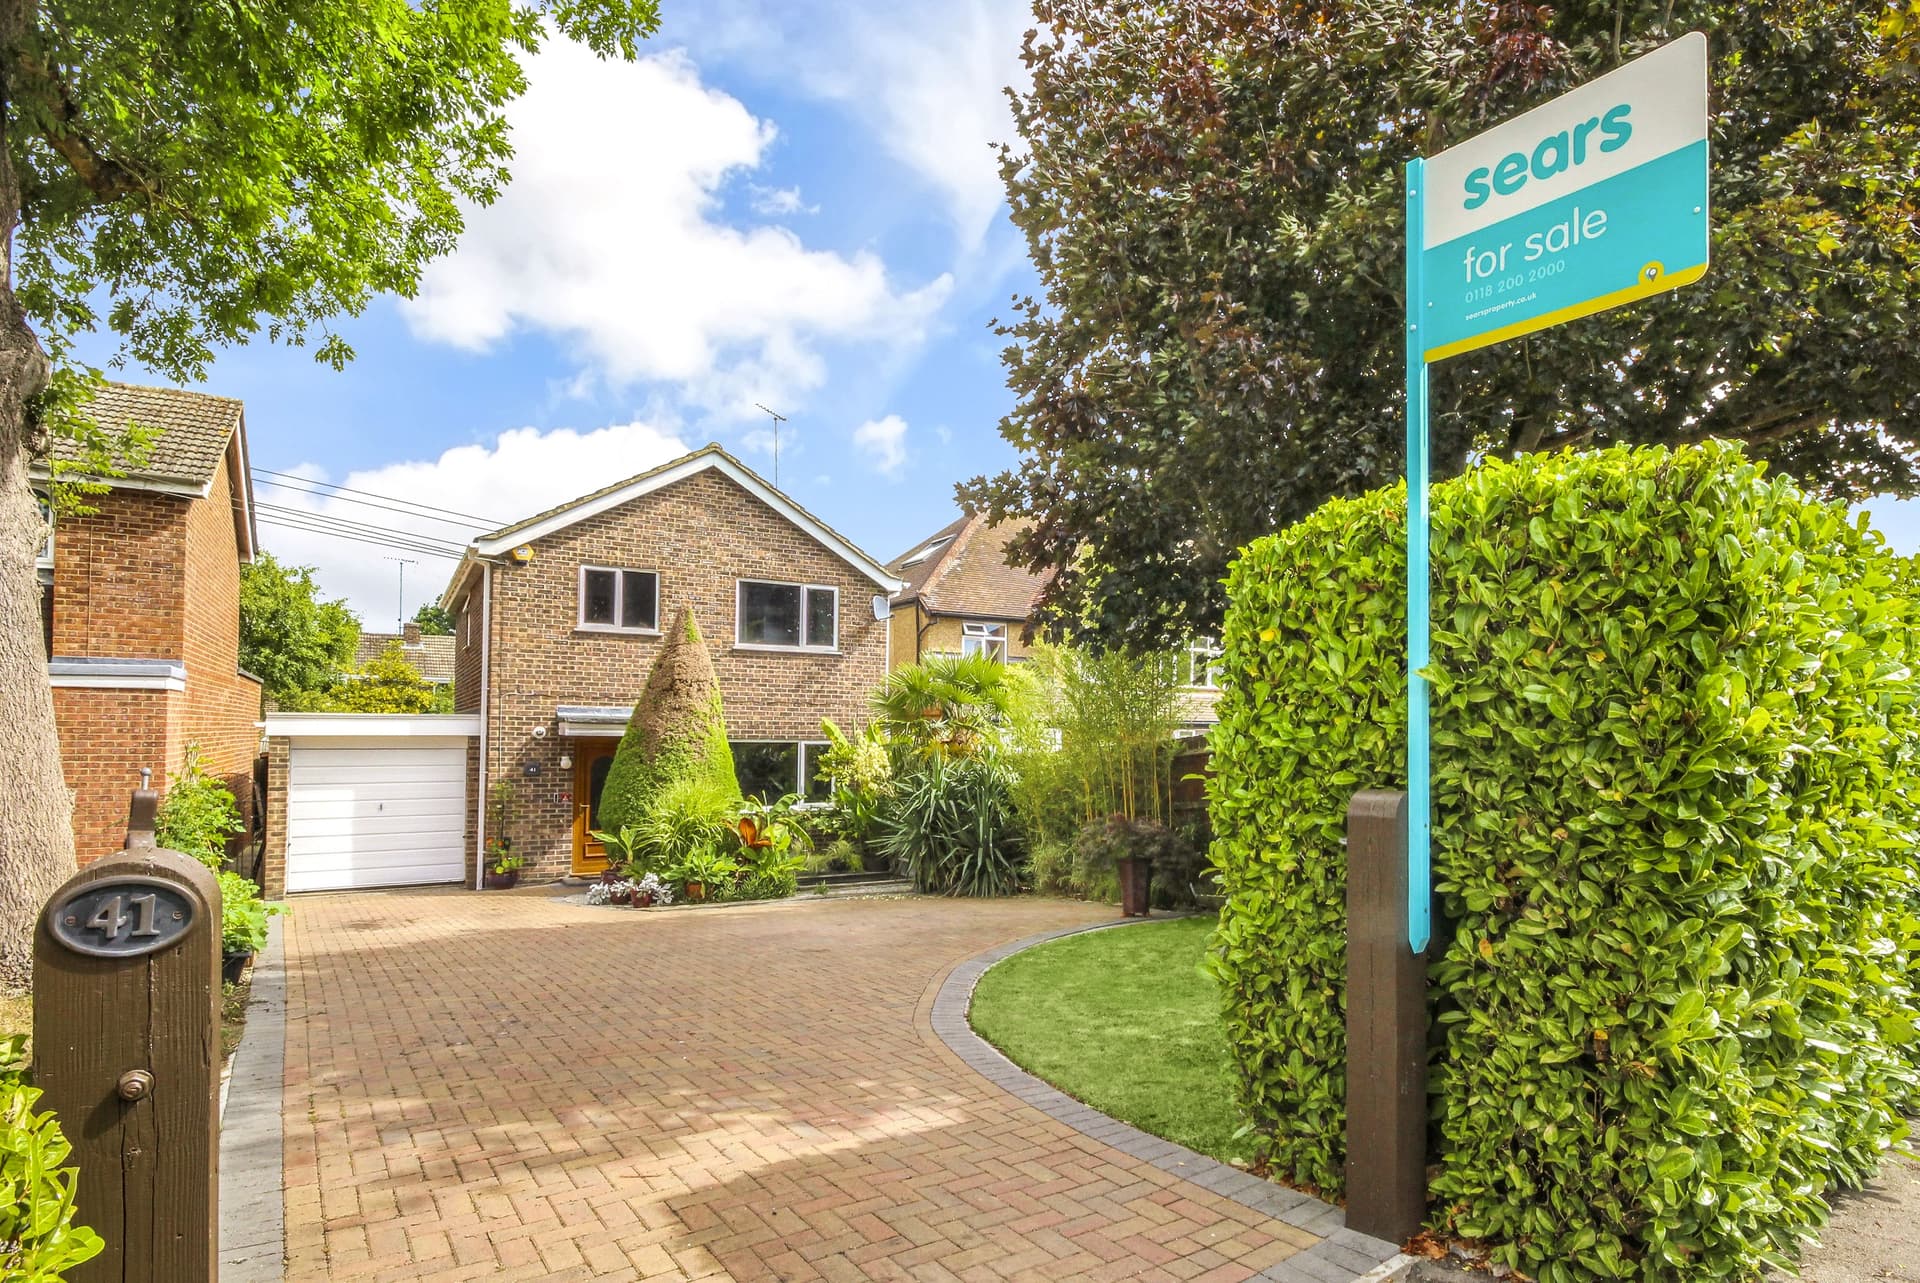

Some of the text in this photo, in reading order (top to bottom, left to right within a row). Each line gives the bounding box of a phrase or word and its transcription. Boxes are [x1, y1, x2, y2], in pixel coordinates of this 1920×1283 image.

[1463, 103, 1633, 210] sears
[1463, 206, 1608, 283] for sale
[1465, 259, 1566, 303] 0118 200 2000
[1465, 292, 1537, 321] searsproperty.co.uk
[85, 893, 161, 939] 41
